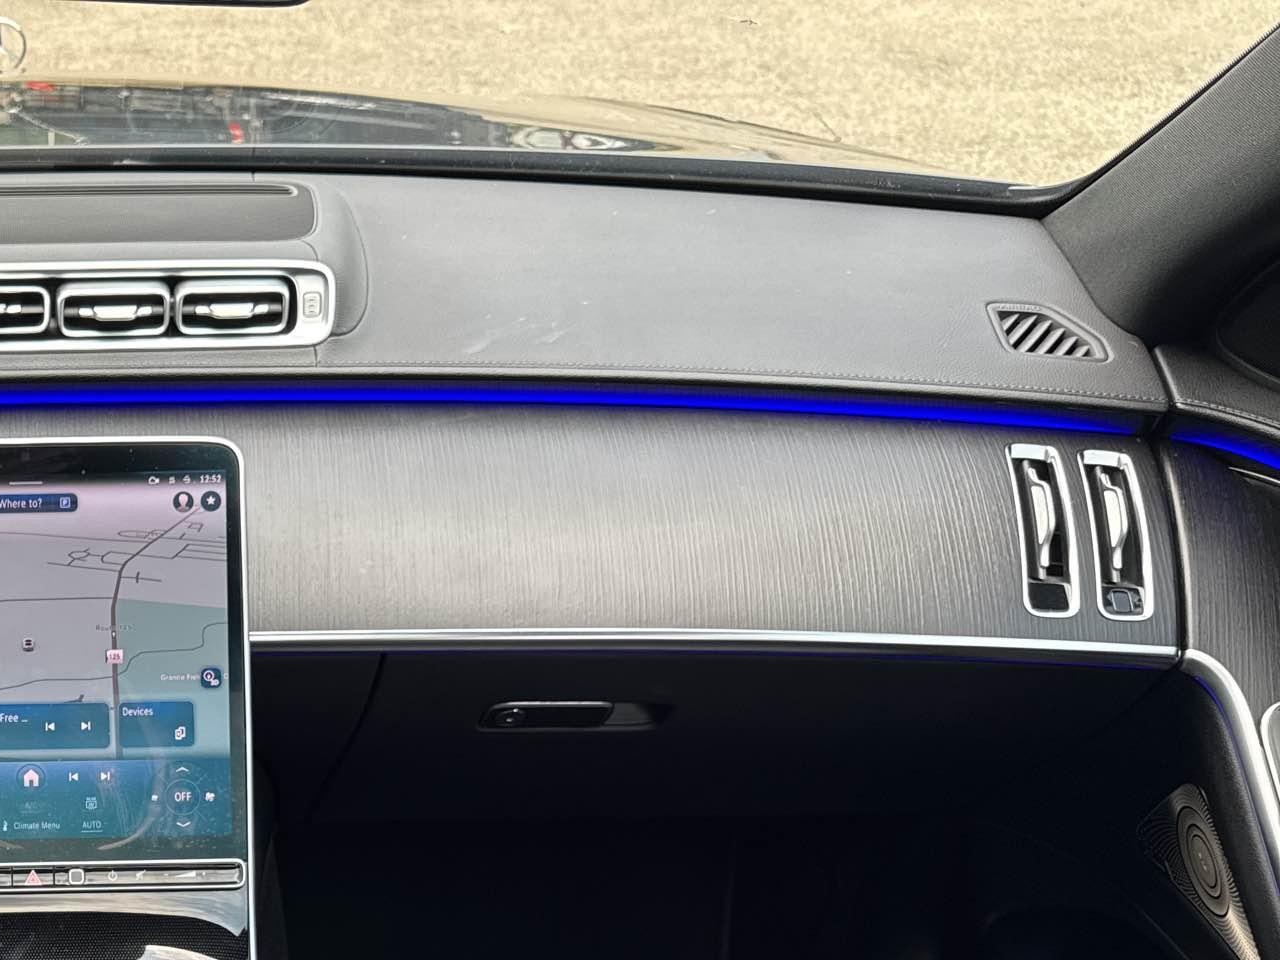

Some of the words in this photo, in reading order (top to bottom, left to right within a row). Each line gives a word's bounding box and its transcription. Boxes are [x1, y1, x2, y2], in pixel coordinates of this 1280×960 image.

[200, 474, 222, 484] 12:52
[29, 498, 43, 508] to?
[122, 707, 153, 716] Devices
[0, 713, 18, 723] Free
[175, 791, 192, 802] OFF
